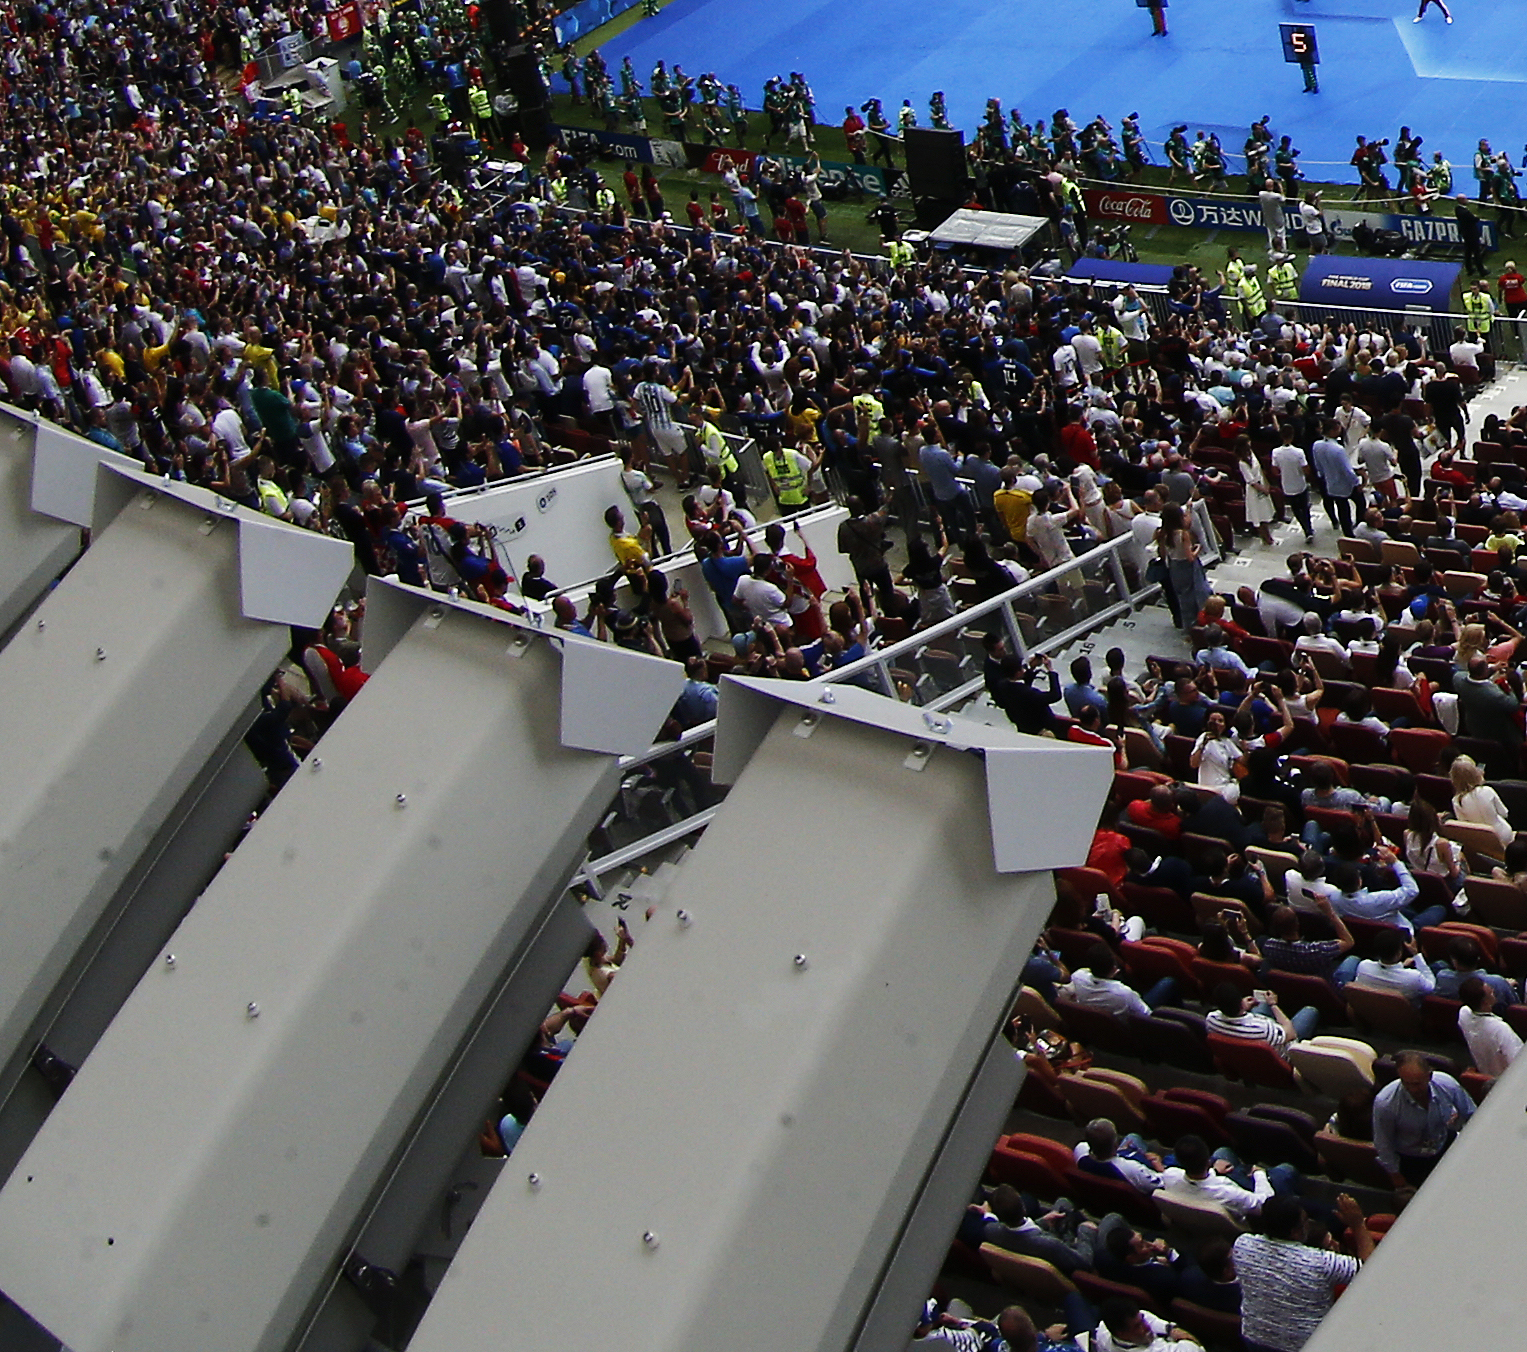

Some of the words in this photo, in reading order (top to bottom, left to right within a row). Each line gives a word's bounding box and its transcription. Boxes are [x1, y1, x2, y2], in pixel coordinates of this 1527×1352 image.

[1292, 33, 1306, 52] 5
[1322, 278, 1350, 289] FINAL
[1350, 281, 1373, 291] 2018
